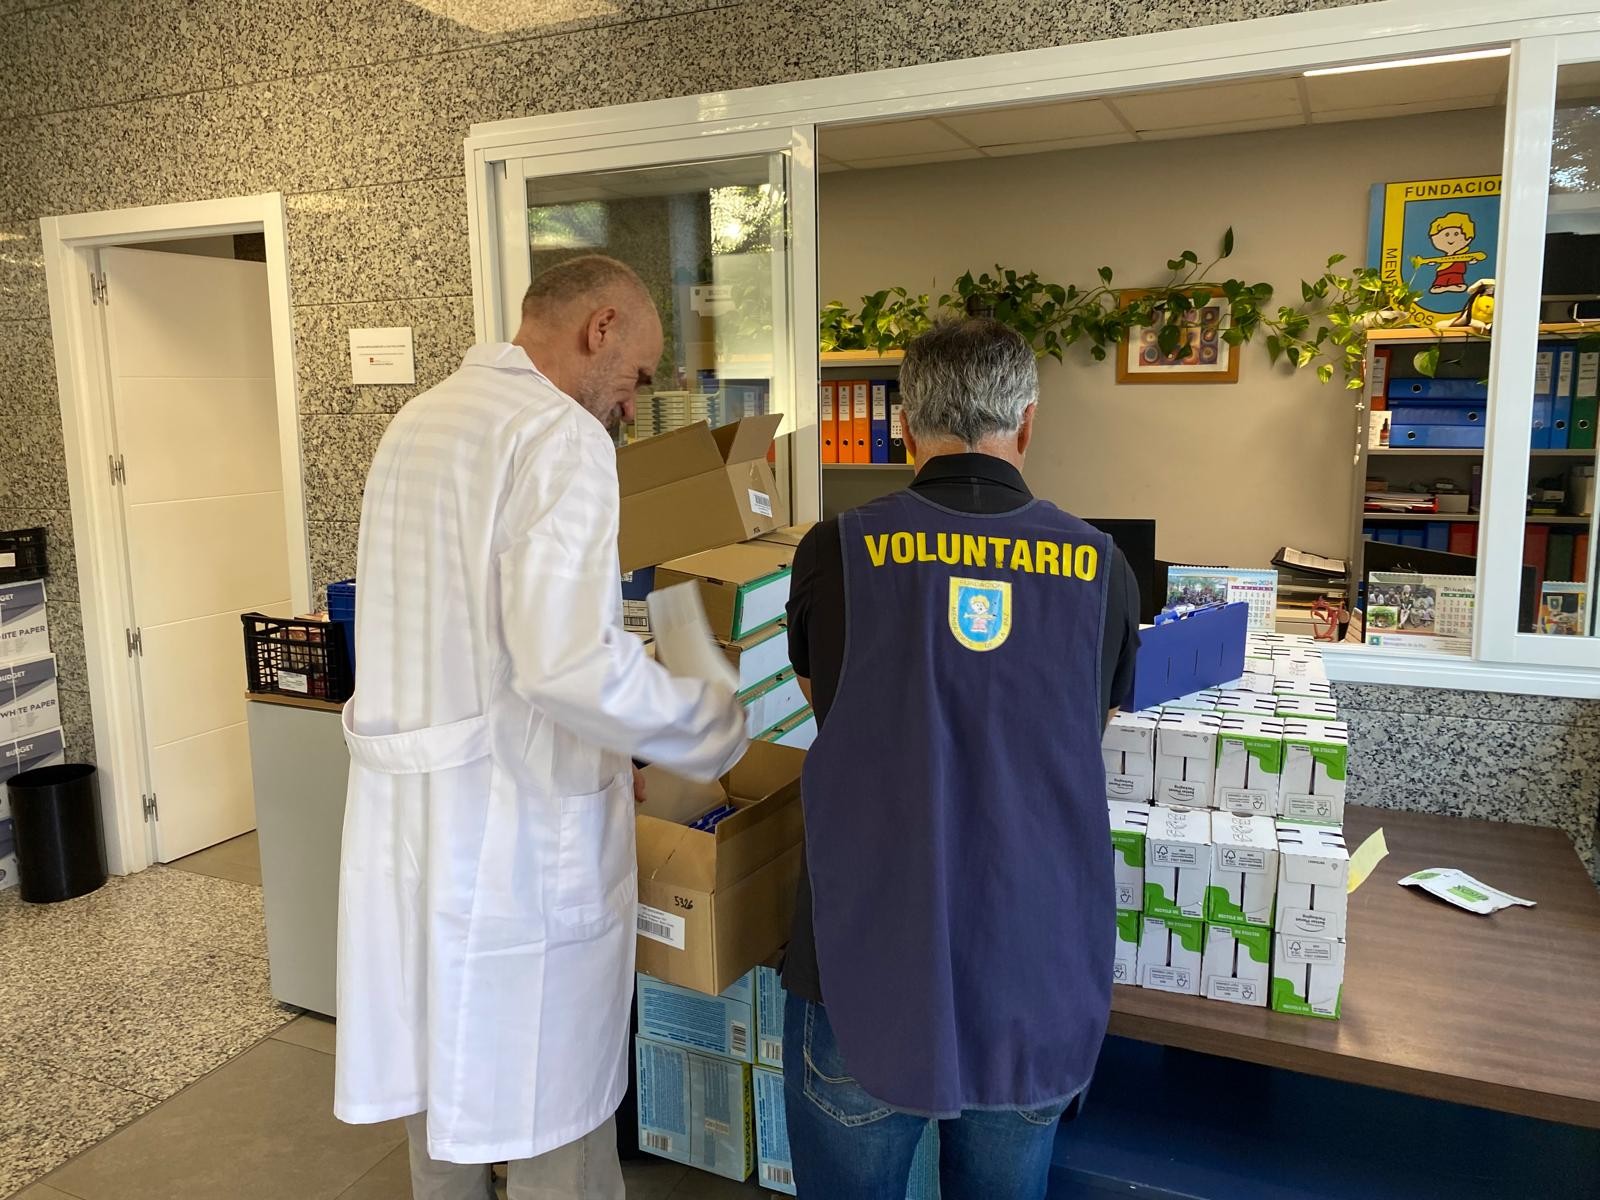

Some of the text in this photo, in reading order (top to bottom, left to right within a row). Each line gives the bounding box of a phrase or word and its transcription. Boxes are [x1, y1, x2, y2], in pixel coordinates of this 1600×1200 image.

[864, 531, 1099, 582] VOLUNTARIO
[19, 625, 46, 637] PAPER
[30, 699, 56, 711] PAPER
[674, 896, 694, 910] 5326
